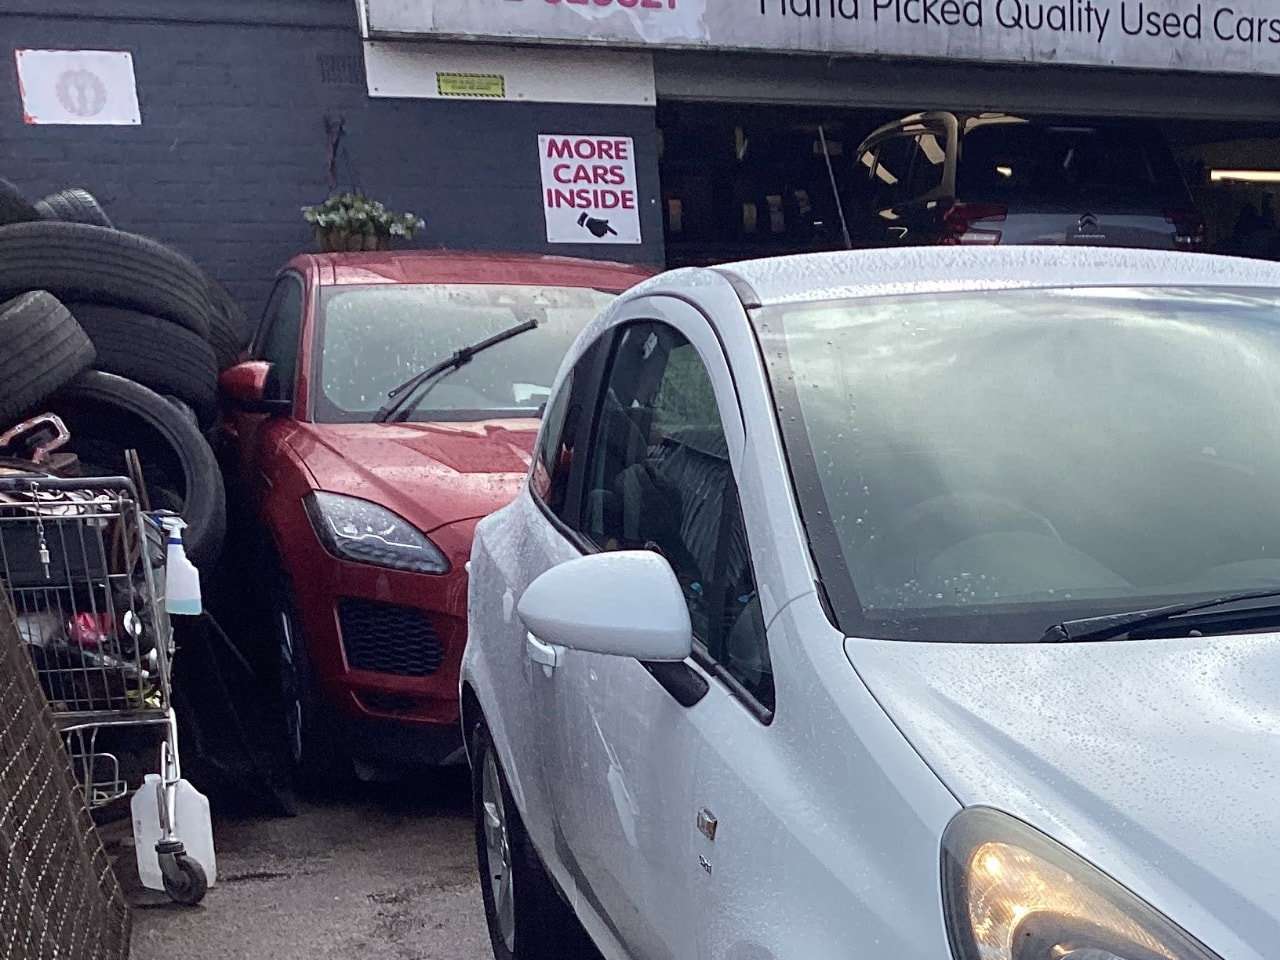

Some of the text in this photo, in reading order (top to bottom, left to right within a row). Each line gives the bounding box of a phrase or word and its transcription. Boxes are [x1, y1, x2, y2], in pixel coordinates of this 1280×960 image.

[995, 0, 1110, 43] Quality
[1121, 0, 1202, 39] Used
[547, 138, 628, 160] MORE
[553, 164, 625, 185] CARS
[546, 188, 635, 209] INSIDE
